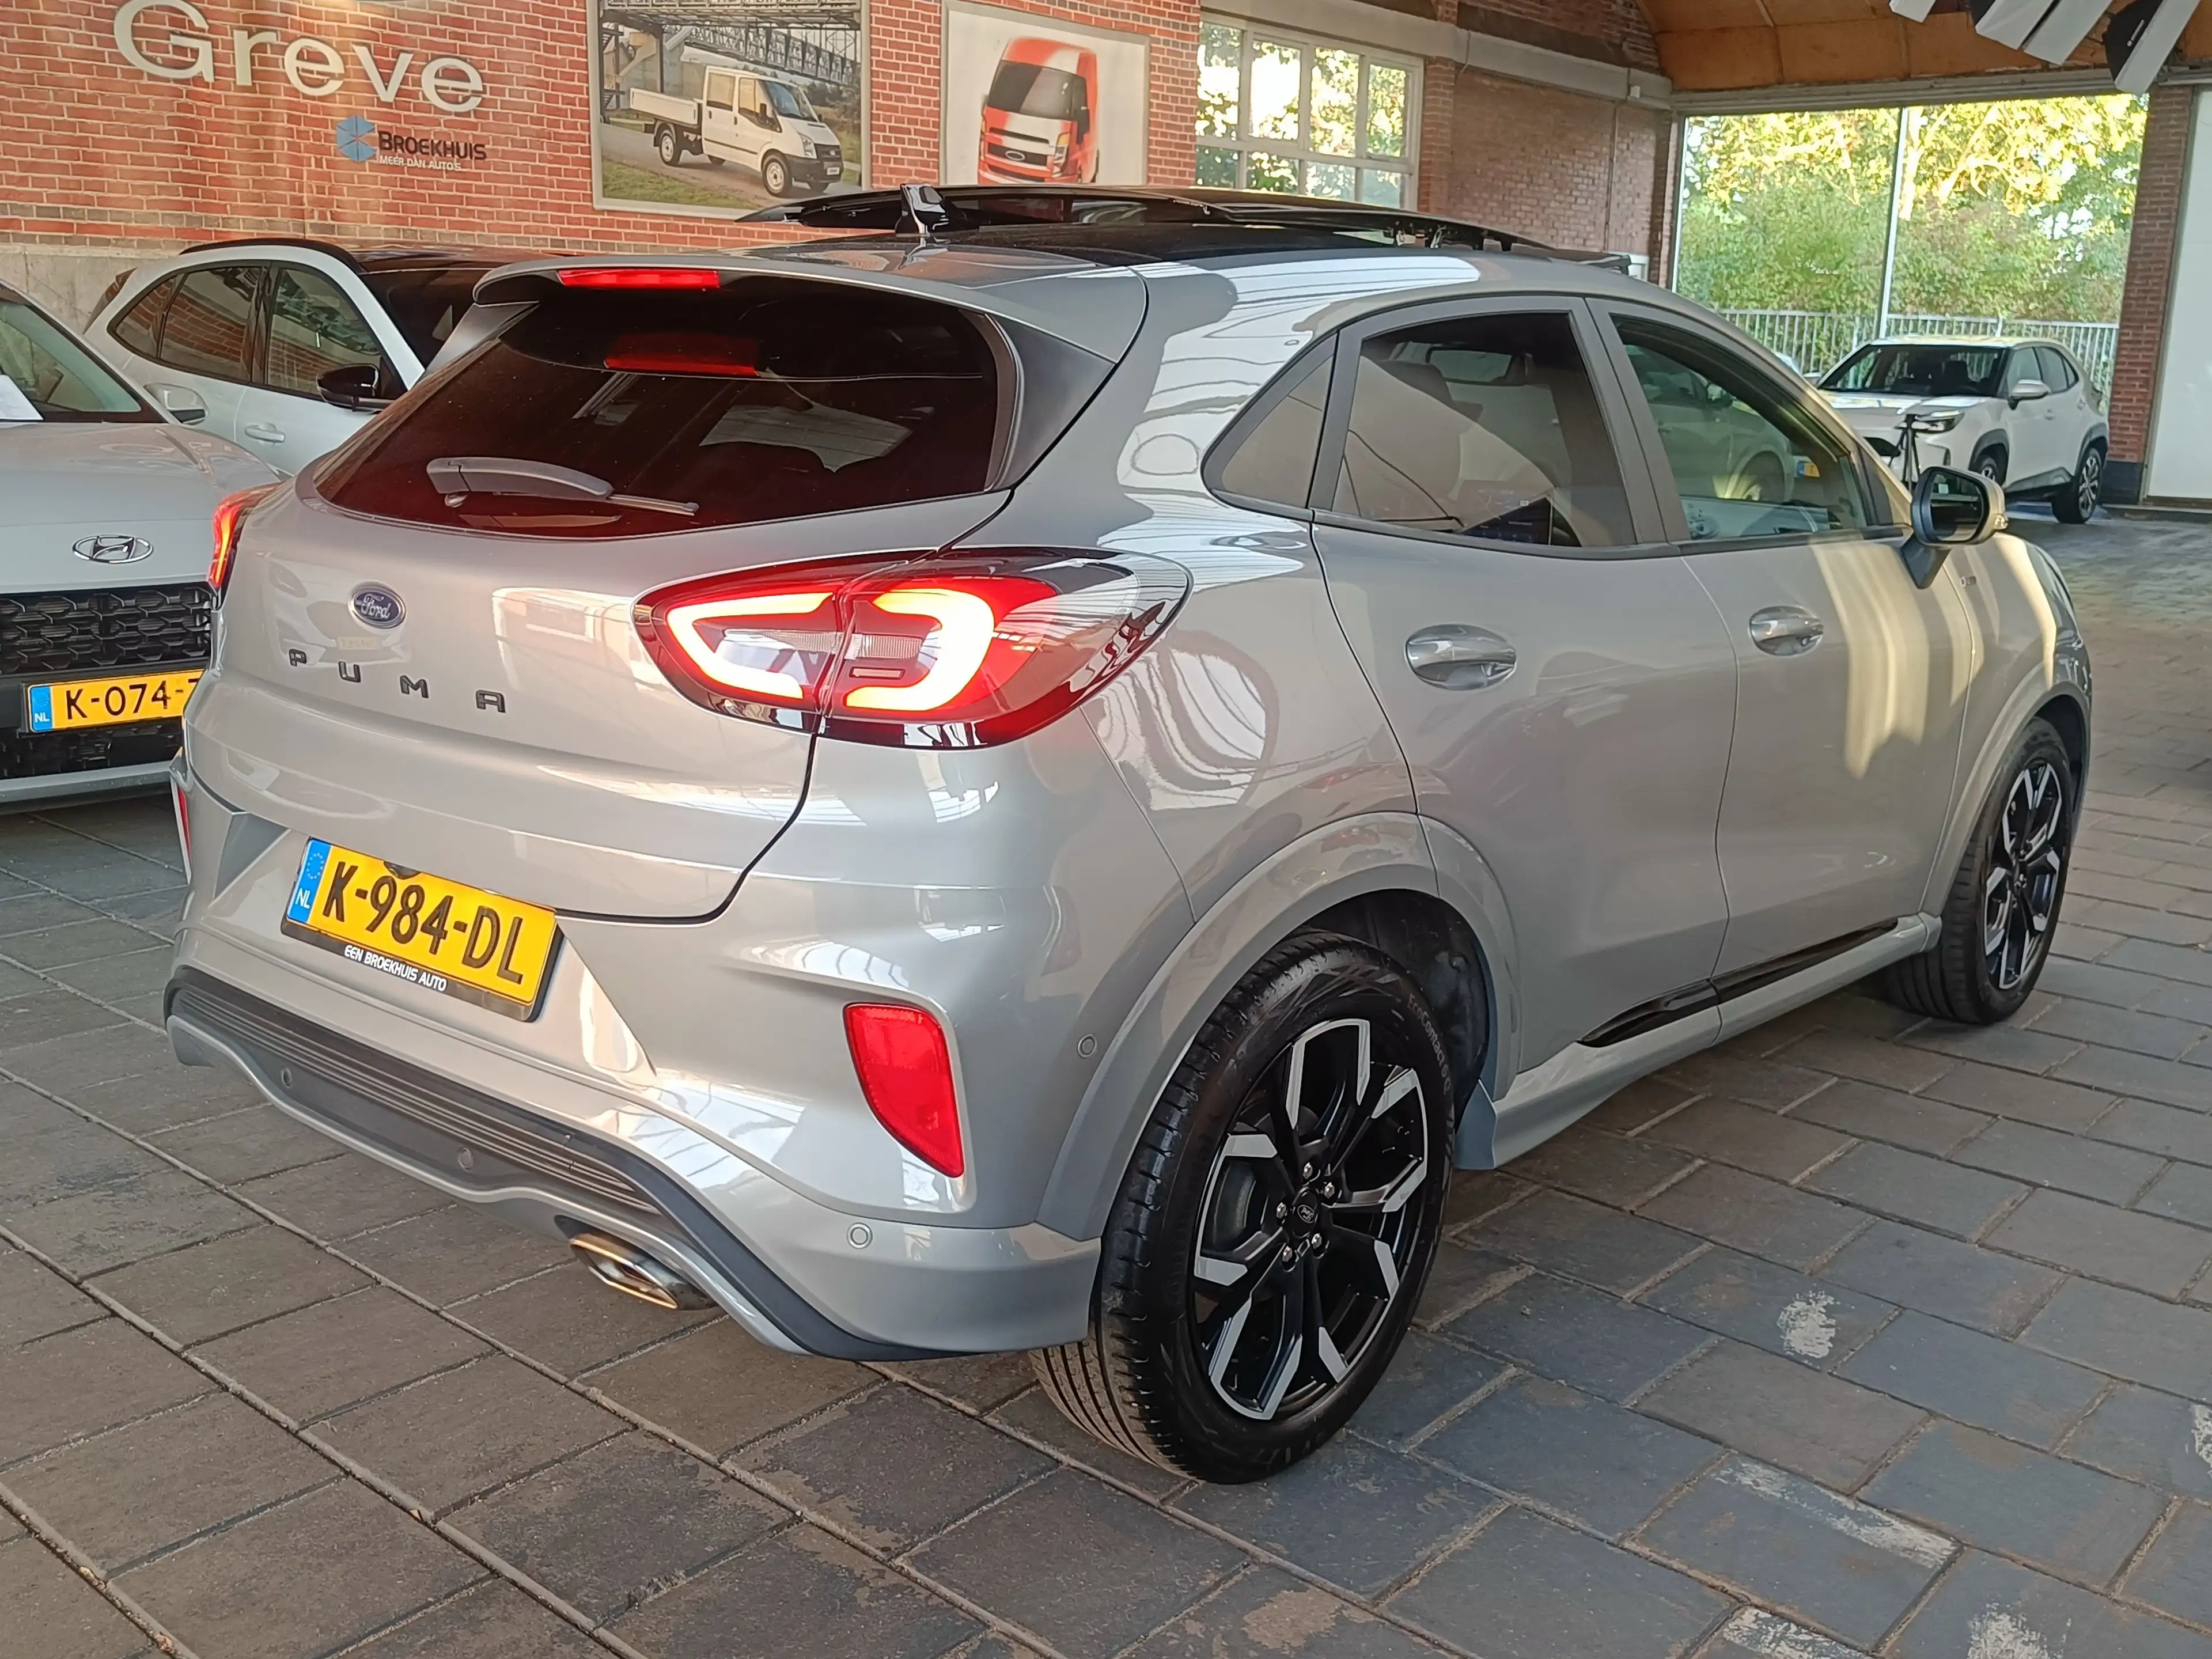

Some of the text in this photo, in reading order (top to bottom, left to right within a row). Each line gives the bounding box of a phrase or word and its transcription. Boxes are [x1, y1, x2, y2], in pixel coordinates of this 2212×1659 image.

[114, 0, 483, 112] Greve
[378, 131, 487, 160] BROEKHUIS
[380, 155, 404, 166] MEER
[407, 158, 426, 168] DAN
[361, 593, 391, 619] Ford
[289, 649, 506, 714] PUMA
[35, 713, 50, 723] NL
[296, 888, 311, 909] NL
[322, 861, 524, 985] K-984-DL
[344, 945, 447, 992] EEN BROEKHUIS AUTO
[1407, 993, 1445, 1067] EcoContact
[1441, 1065, 1449, 1077] 6
